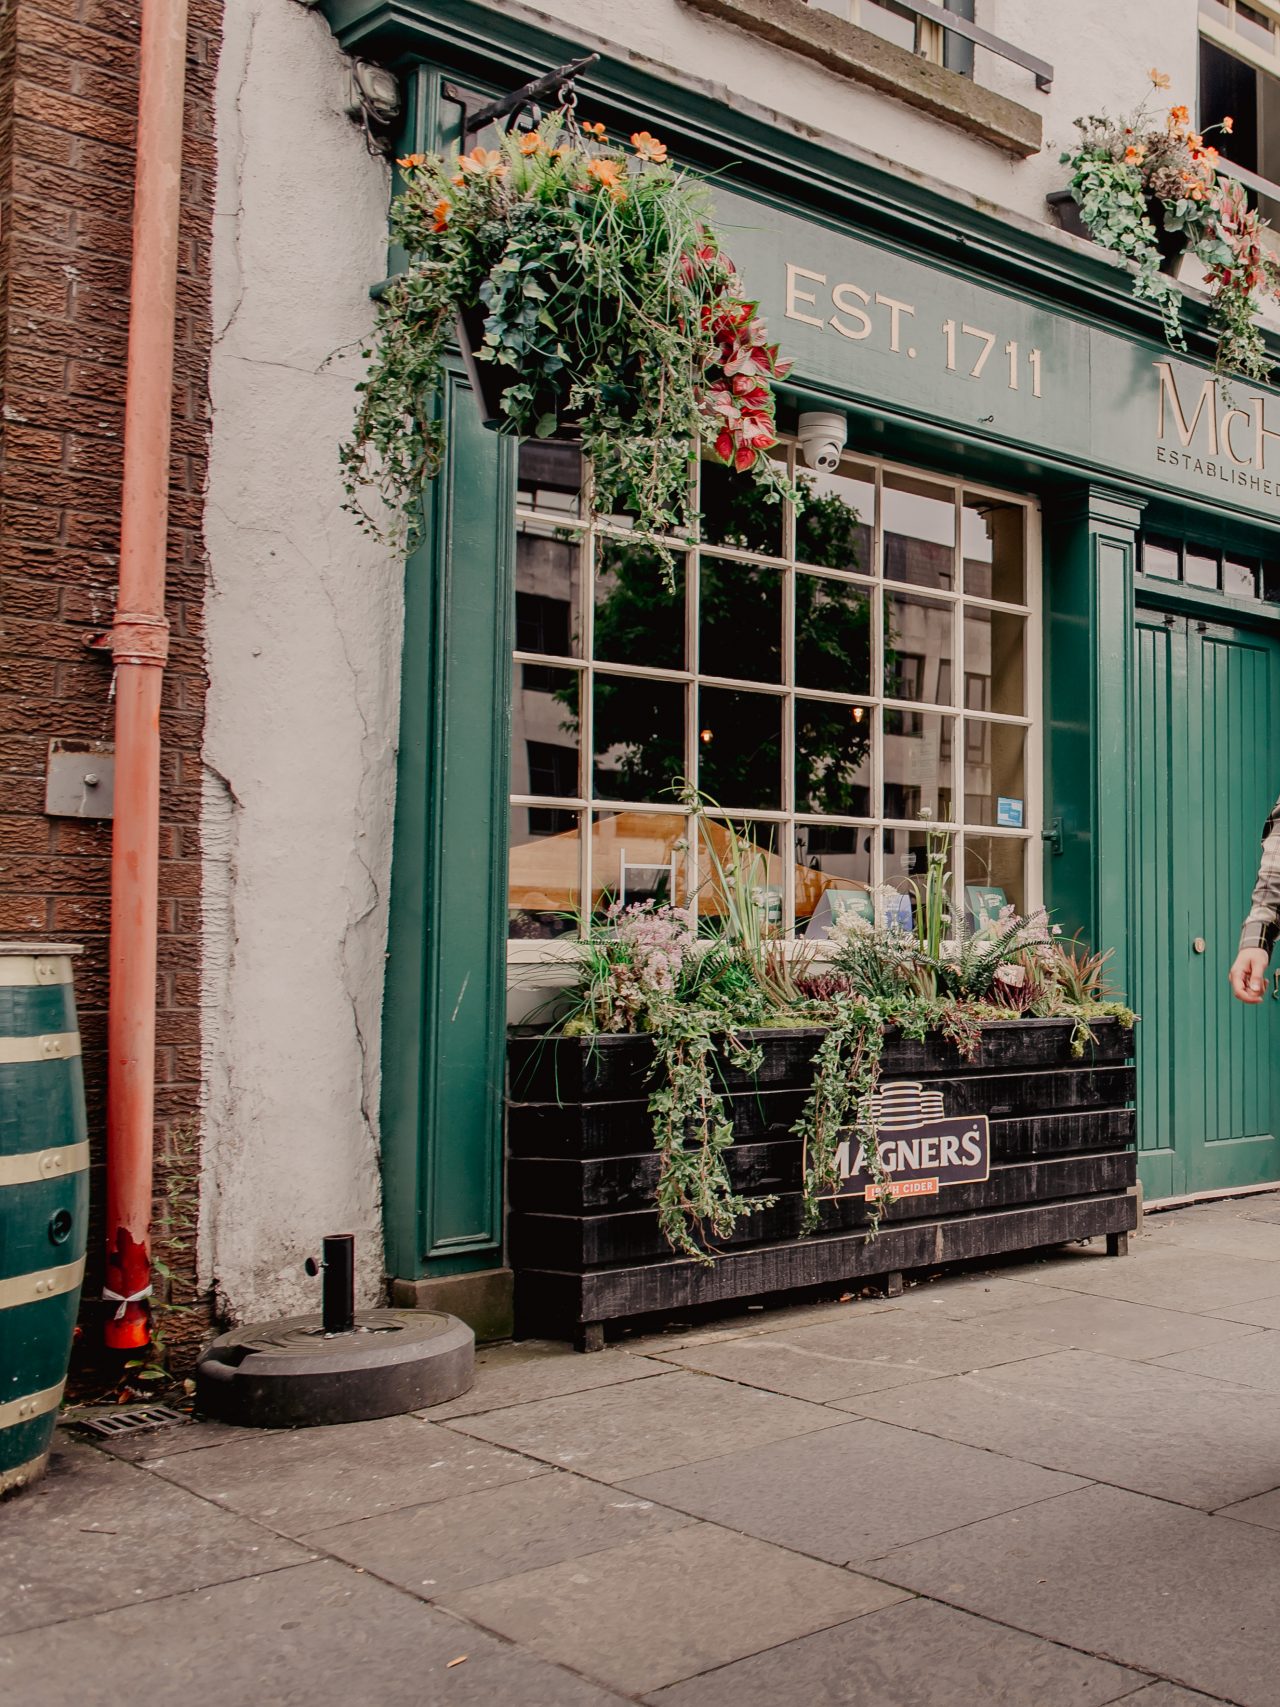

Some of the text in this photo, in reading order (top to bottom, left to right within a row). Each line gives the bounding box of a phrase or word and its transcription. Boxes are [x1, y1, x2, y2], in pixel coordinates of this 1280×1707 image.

[783, 262, 1043, 399] EST. 1711
[871, 1181, 934, 1197] IRH CIDER
